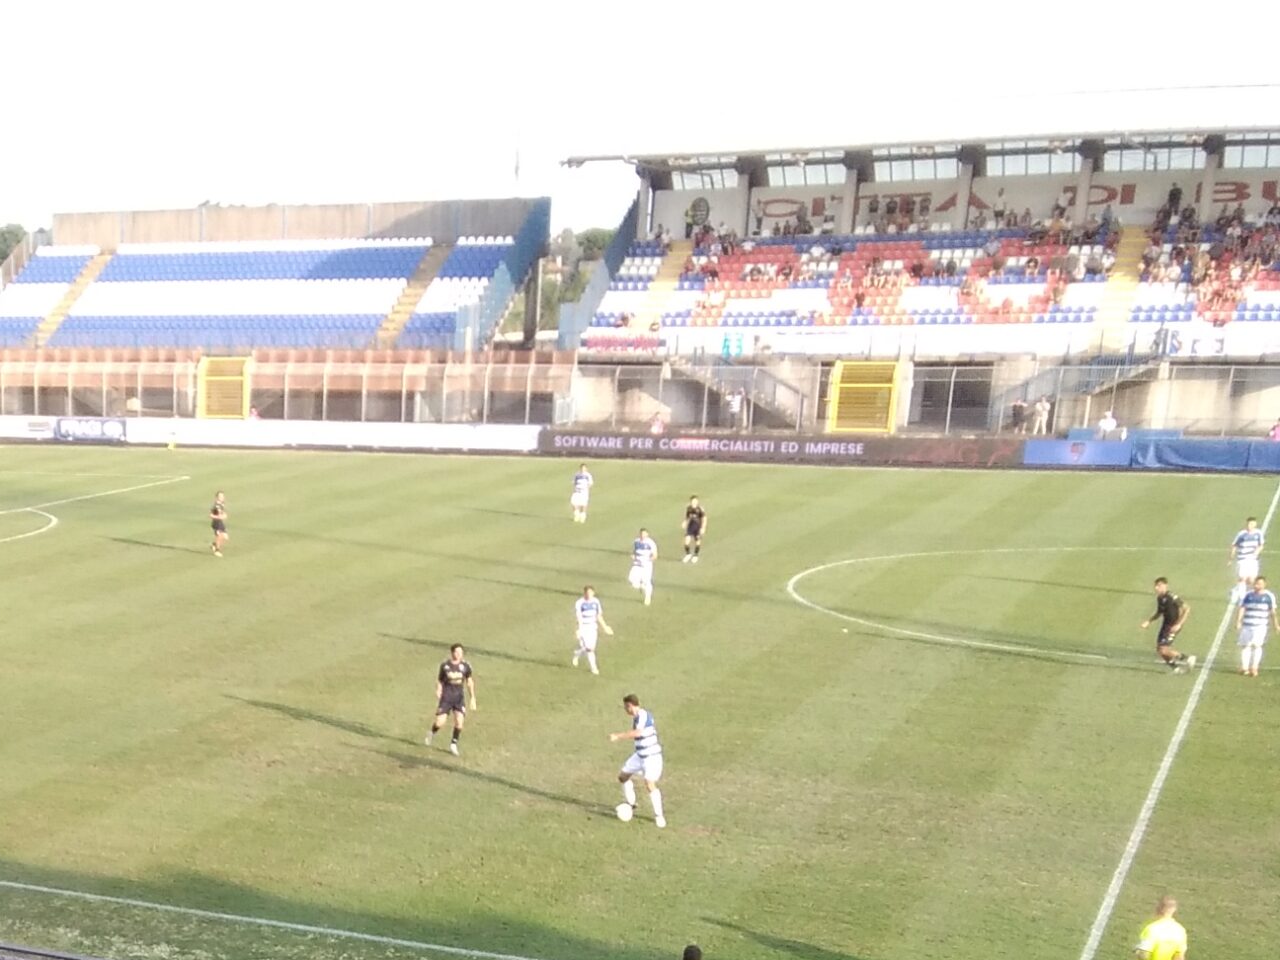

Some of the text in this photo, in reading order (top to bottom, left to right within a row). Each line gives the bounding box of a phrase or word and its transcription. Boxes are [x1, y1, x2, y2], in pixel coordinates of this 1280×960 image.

[554, 435, 624, 449] SOFTWARE
[629, 437, 654, 449] PER
[780, 440, 799, 453] ED
[805, 442, 865, 455] IMPRESE
